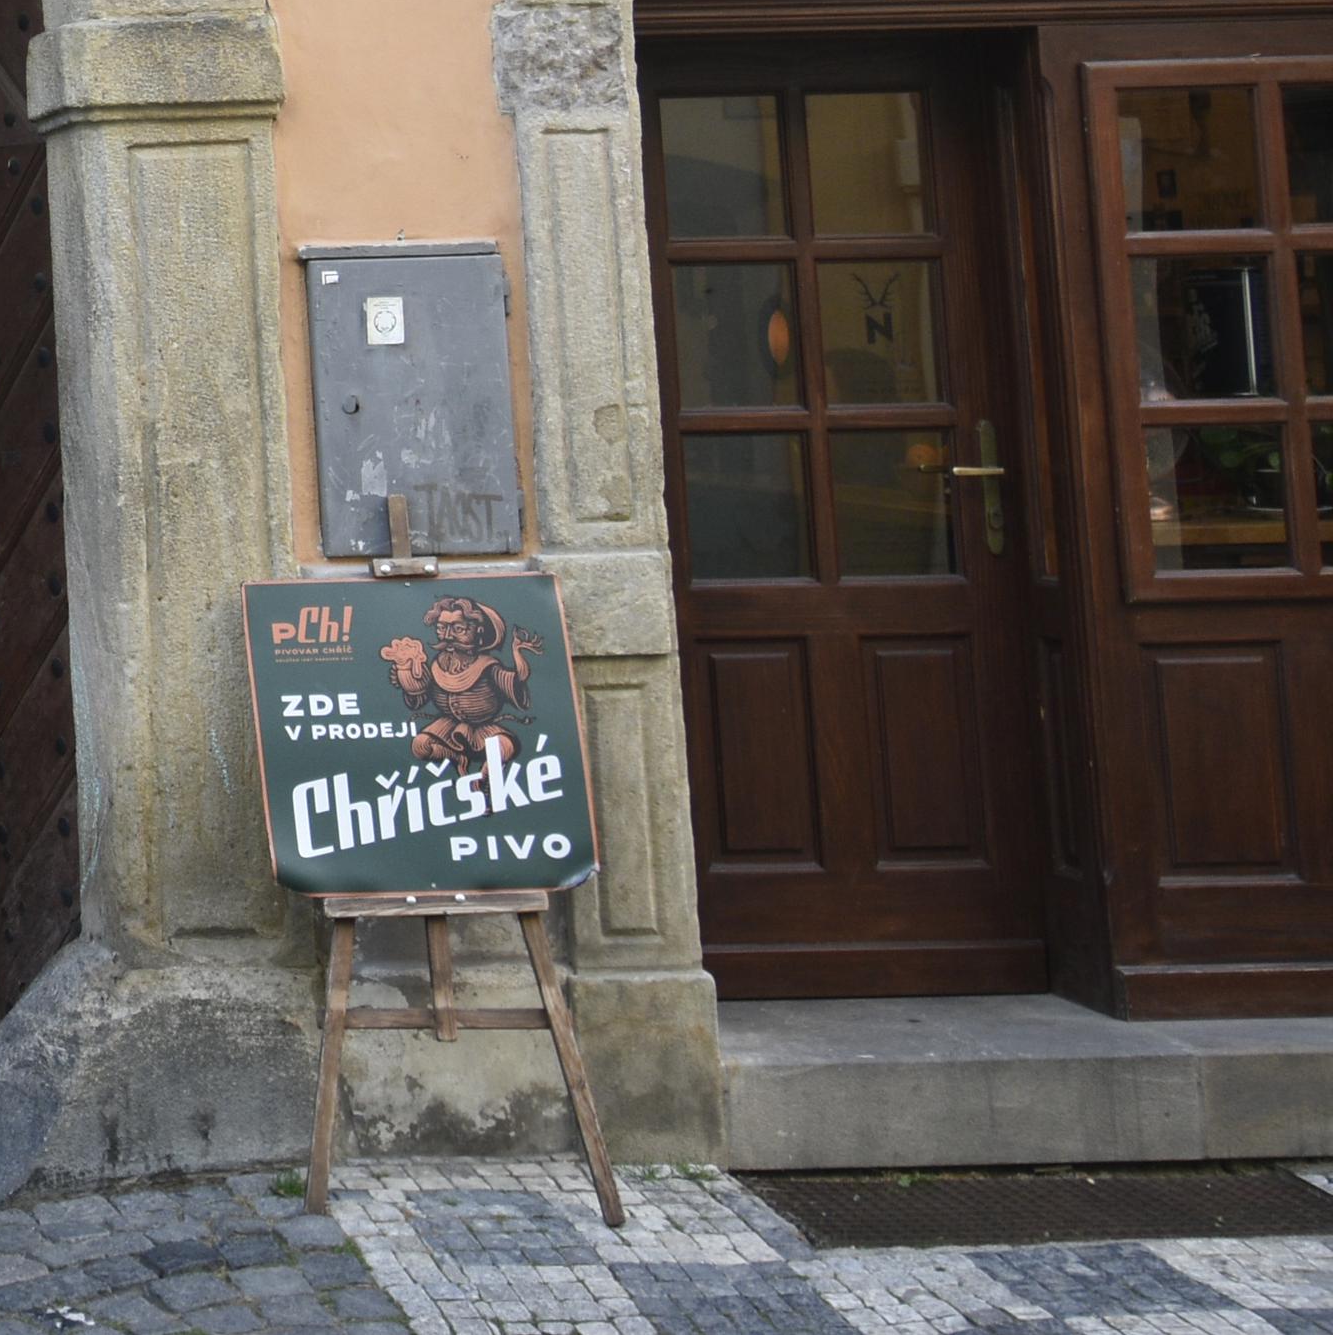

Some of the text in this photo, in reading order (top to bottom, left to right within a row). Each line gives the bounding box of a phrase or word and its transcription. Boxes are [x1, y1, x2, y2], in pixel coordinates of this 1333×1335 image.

[274, 648, 319, 656] PIVOVAR
[281, 693, 361, 718] ZDE
[284, 721, 417, 741] V PRODEJI
[292, 734, 564, 859] Chříčské
[450, 832, 572, 862] PIVO
